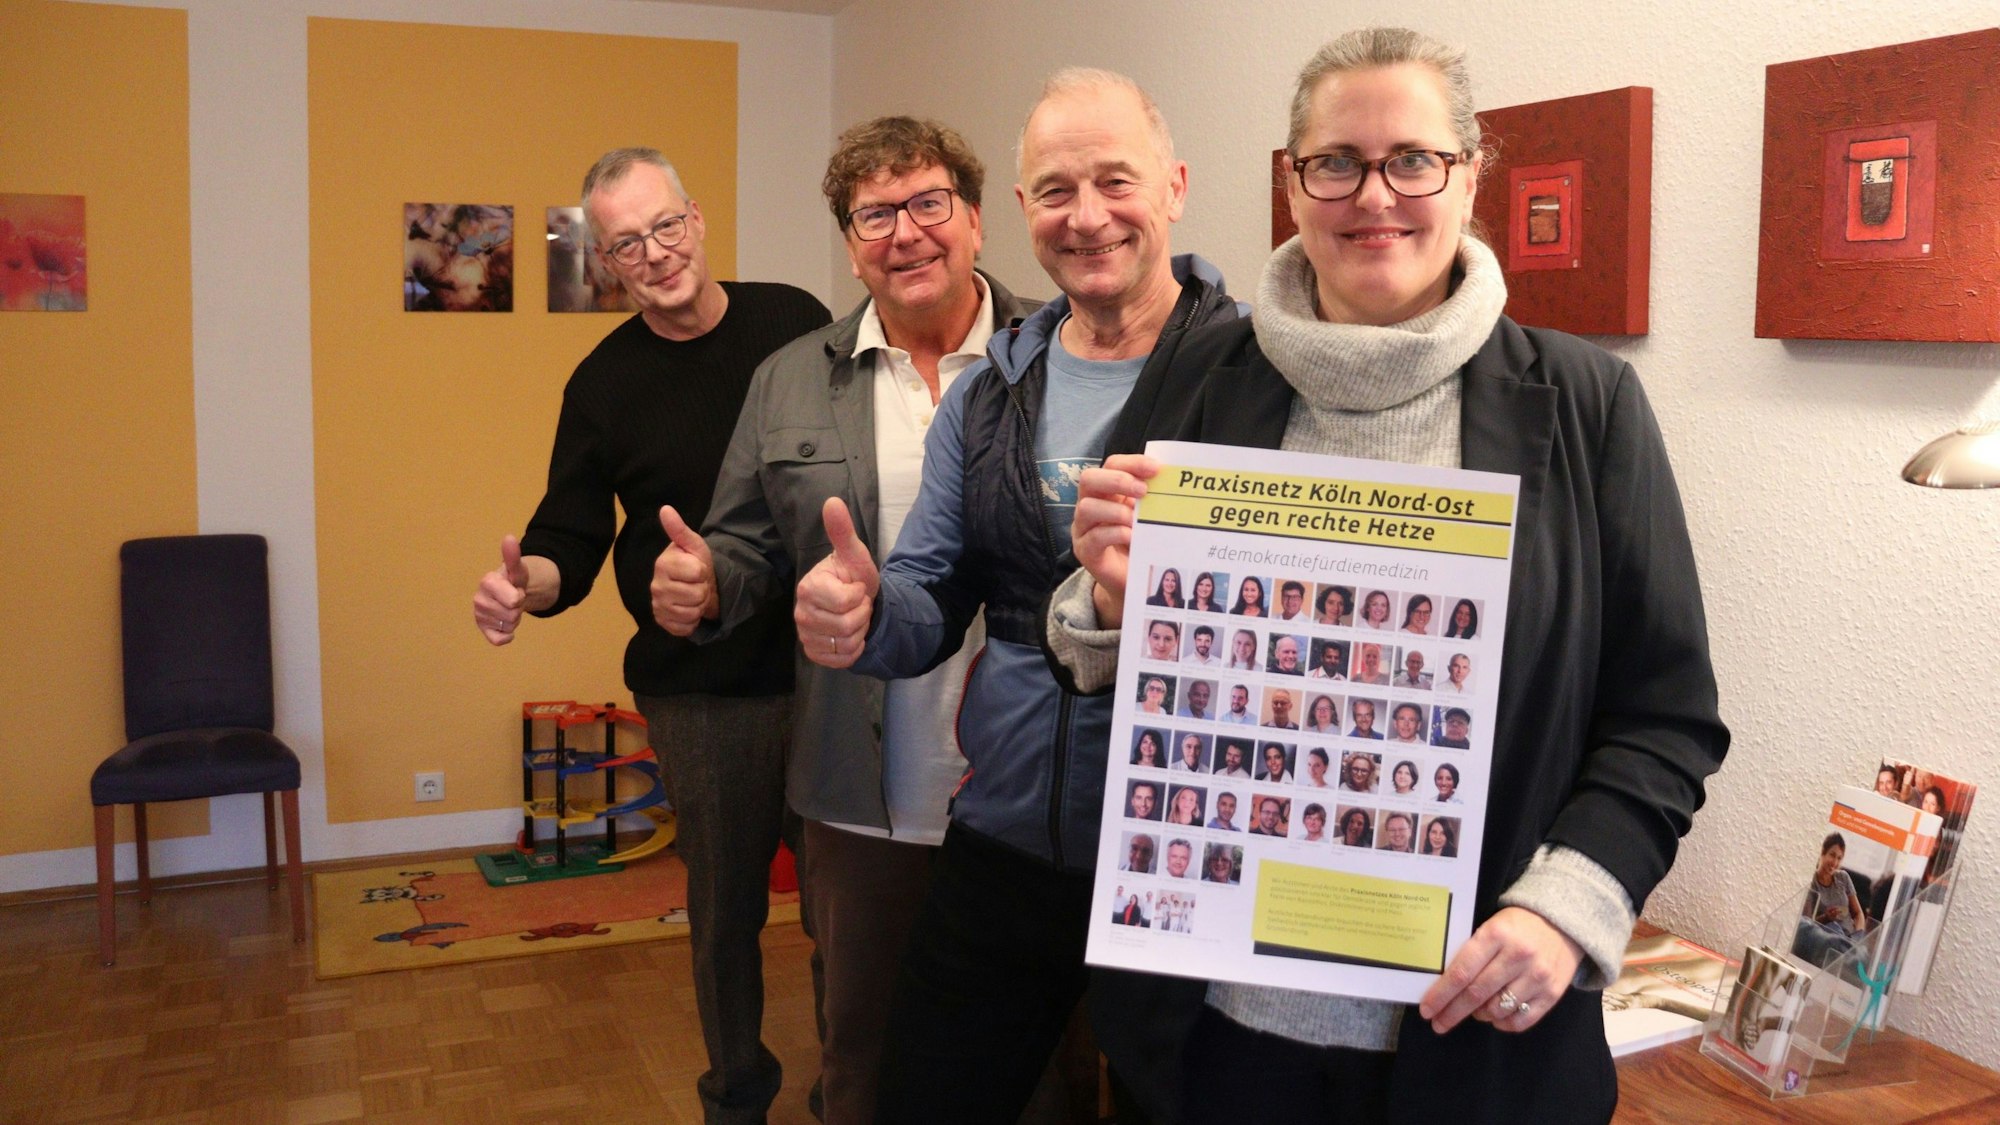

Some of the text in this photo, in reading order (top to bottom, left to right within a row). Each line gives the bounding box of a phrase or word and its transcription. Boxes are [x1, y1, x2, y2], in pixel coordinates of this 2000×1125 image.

[1179, 470, 1475, 516] Praxisnetz Köln Nord-Ost
[1209, 505, 1435, 541] gegen rechte Hetze
[1208, 545, 1429, 581] #demokratiefürdiemedizin
[1654, 965, 1731, 1000] Osteoporo
